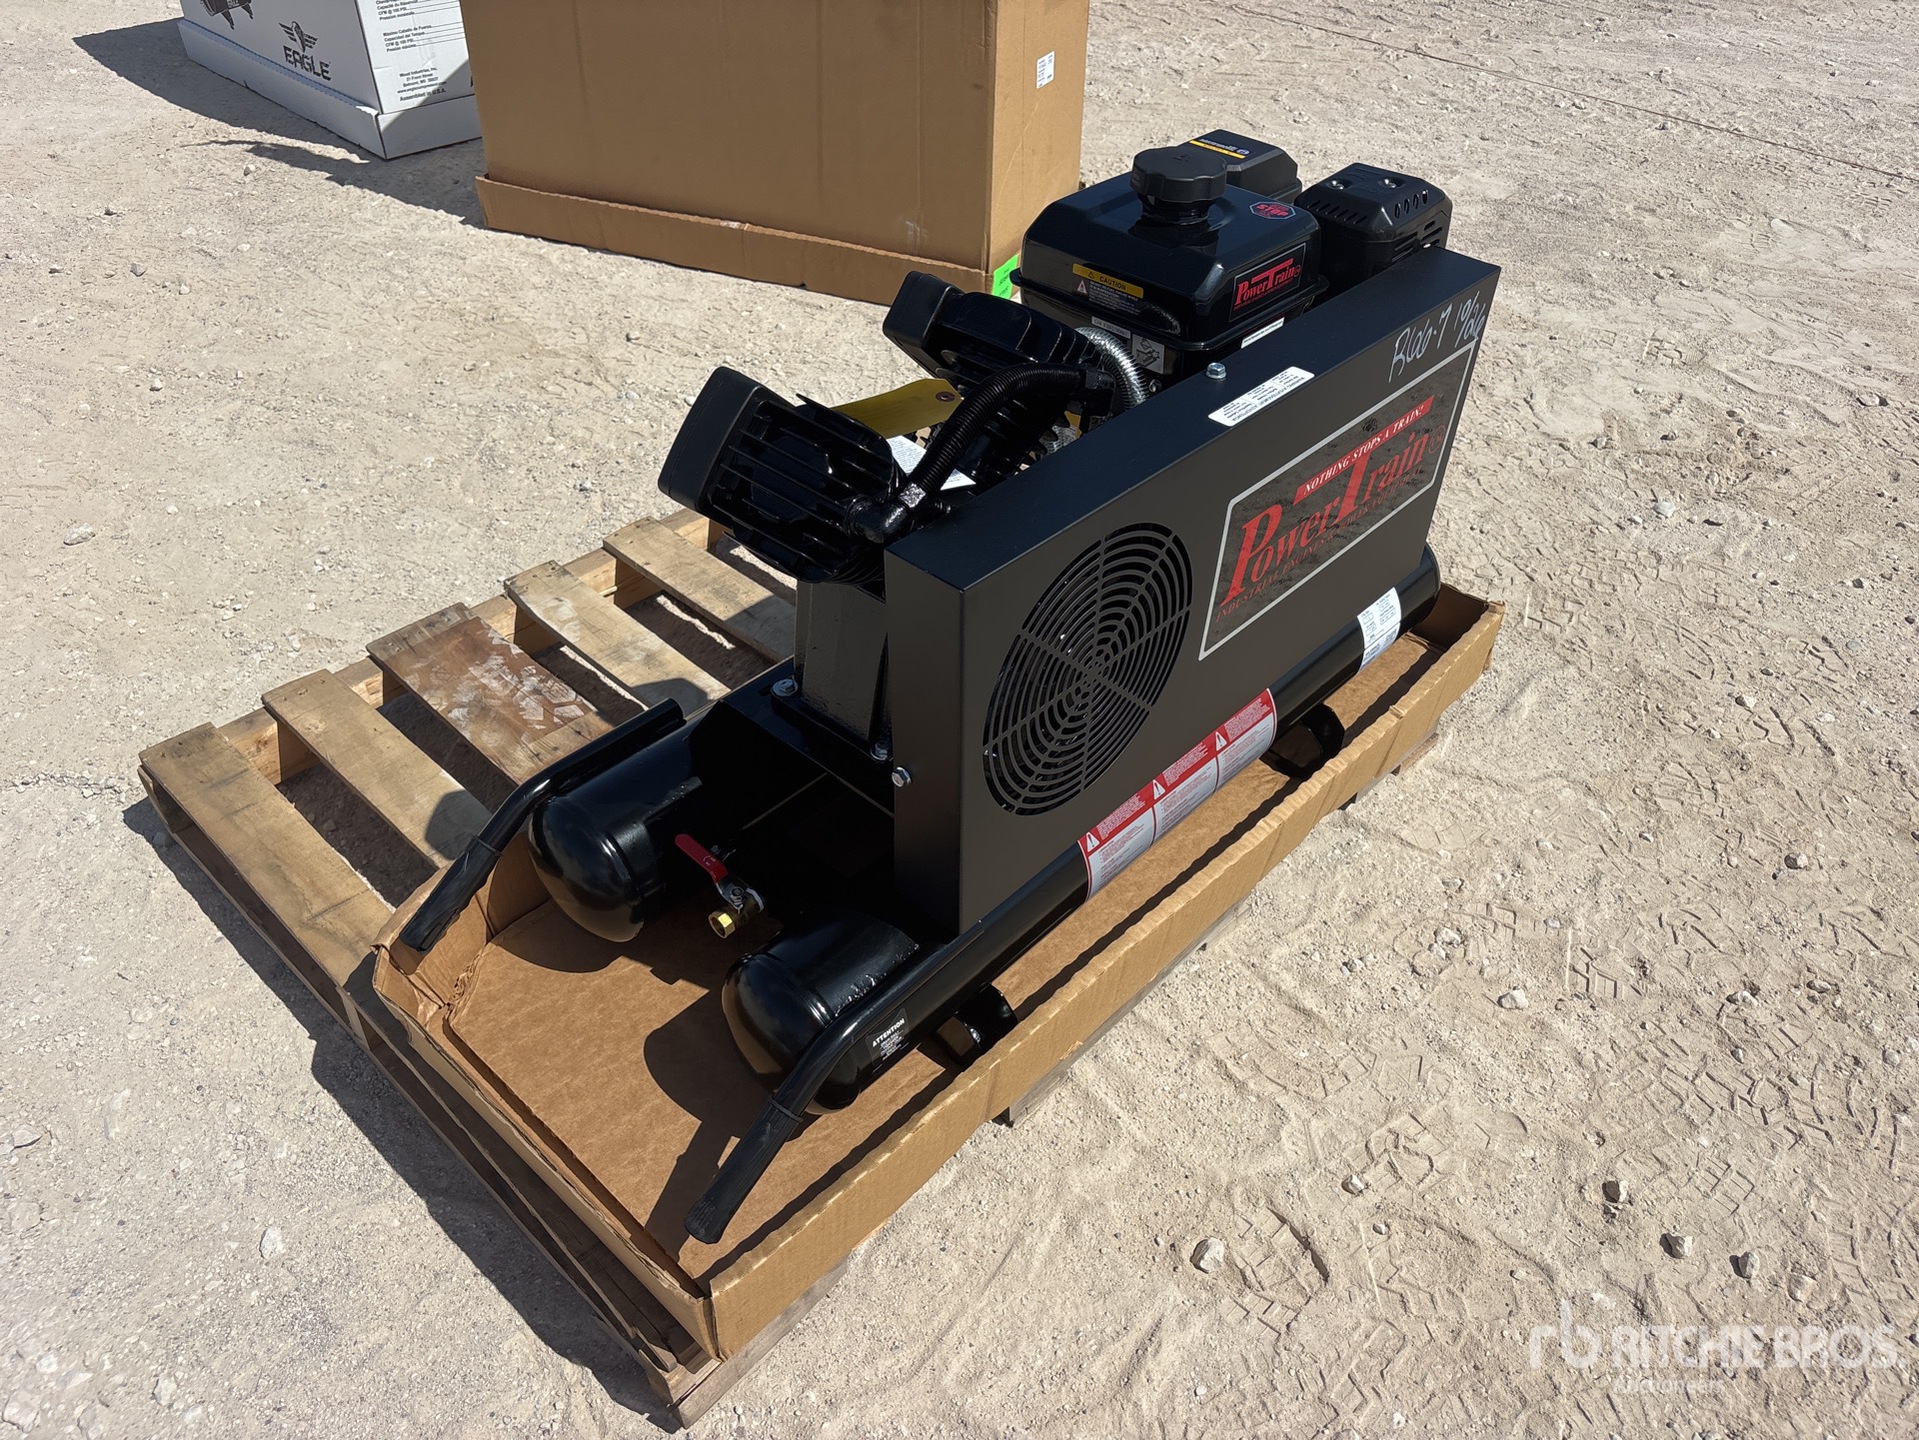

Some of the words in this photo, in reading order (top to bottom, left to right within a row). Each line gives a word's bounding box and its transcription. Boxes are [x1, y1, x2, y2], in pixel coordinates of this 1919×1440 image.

[283, 45, 331, 81] EAGLE
[1257, 204, 1289, 217] STOP
[1100, 276, 1126, 291] CAUTION
[1304, 456, 1350, 495] NOTHING
[1352, 434, 1382, 462] STOPS
[873, 1018, 905, 1047] ATTENTION
